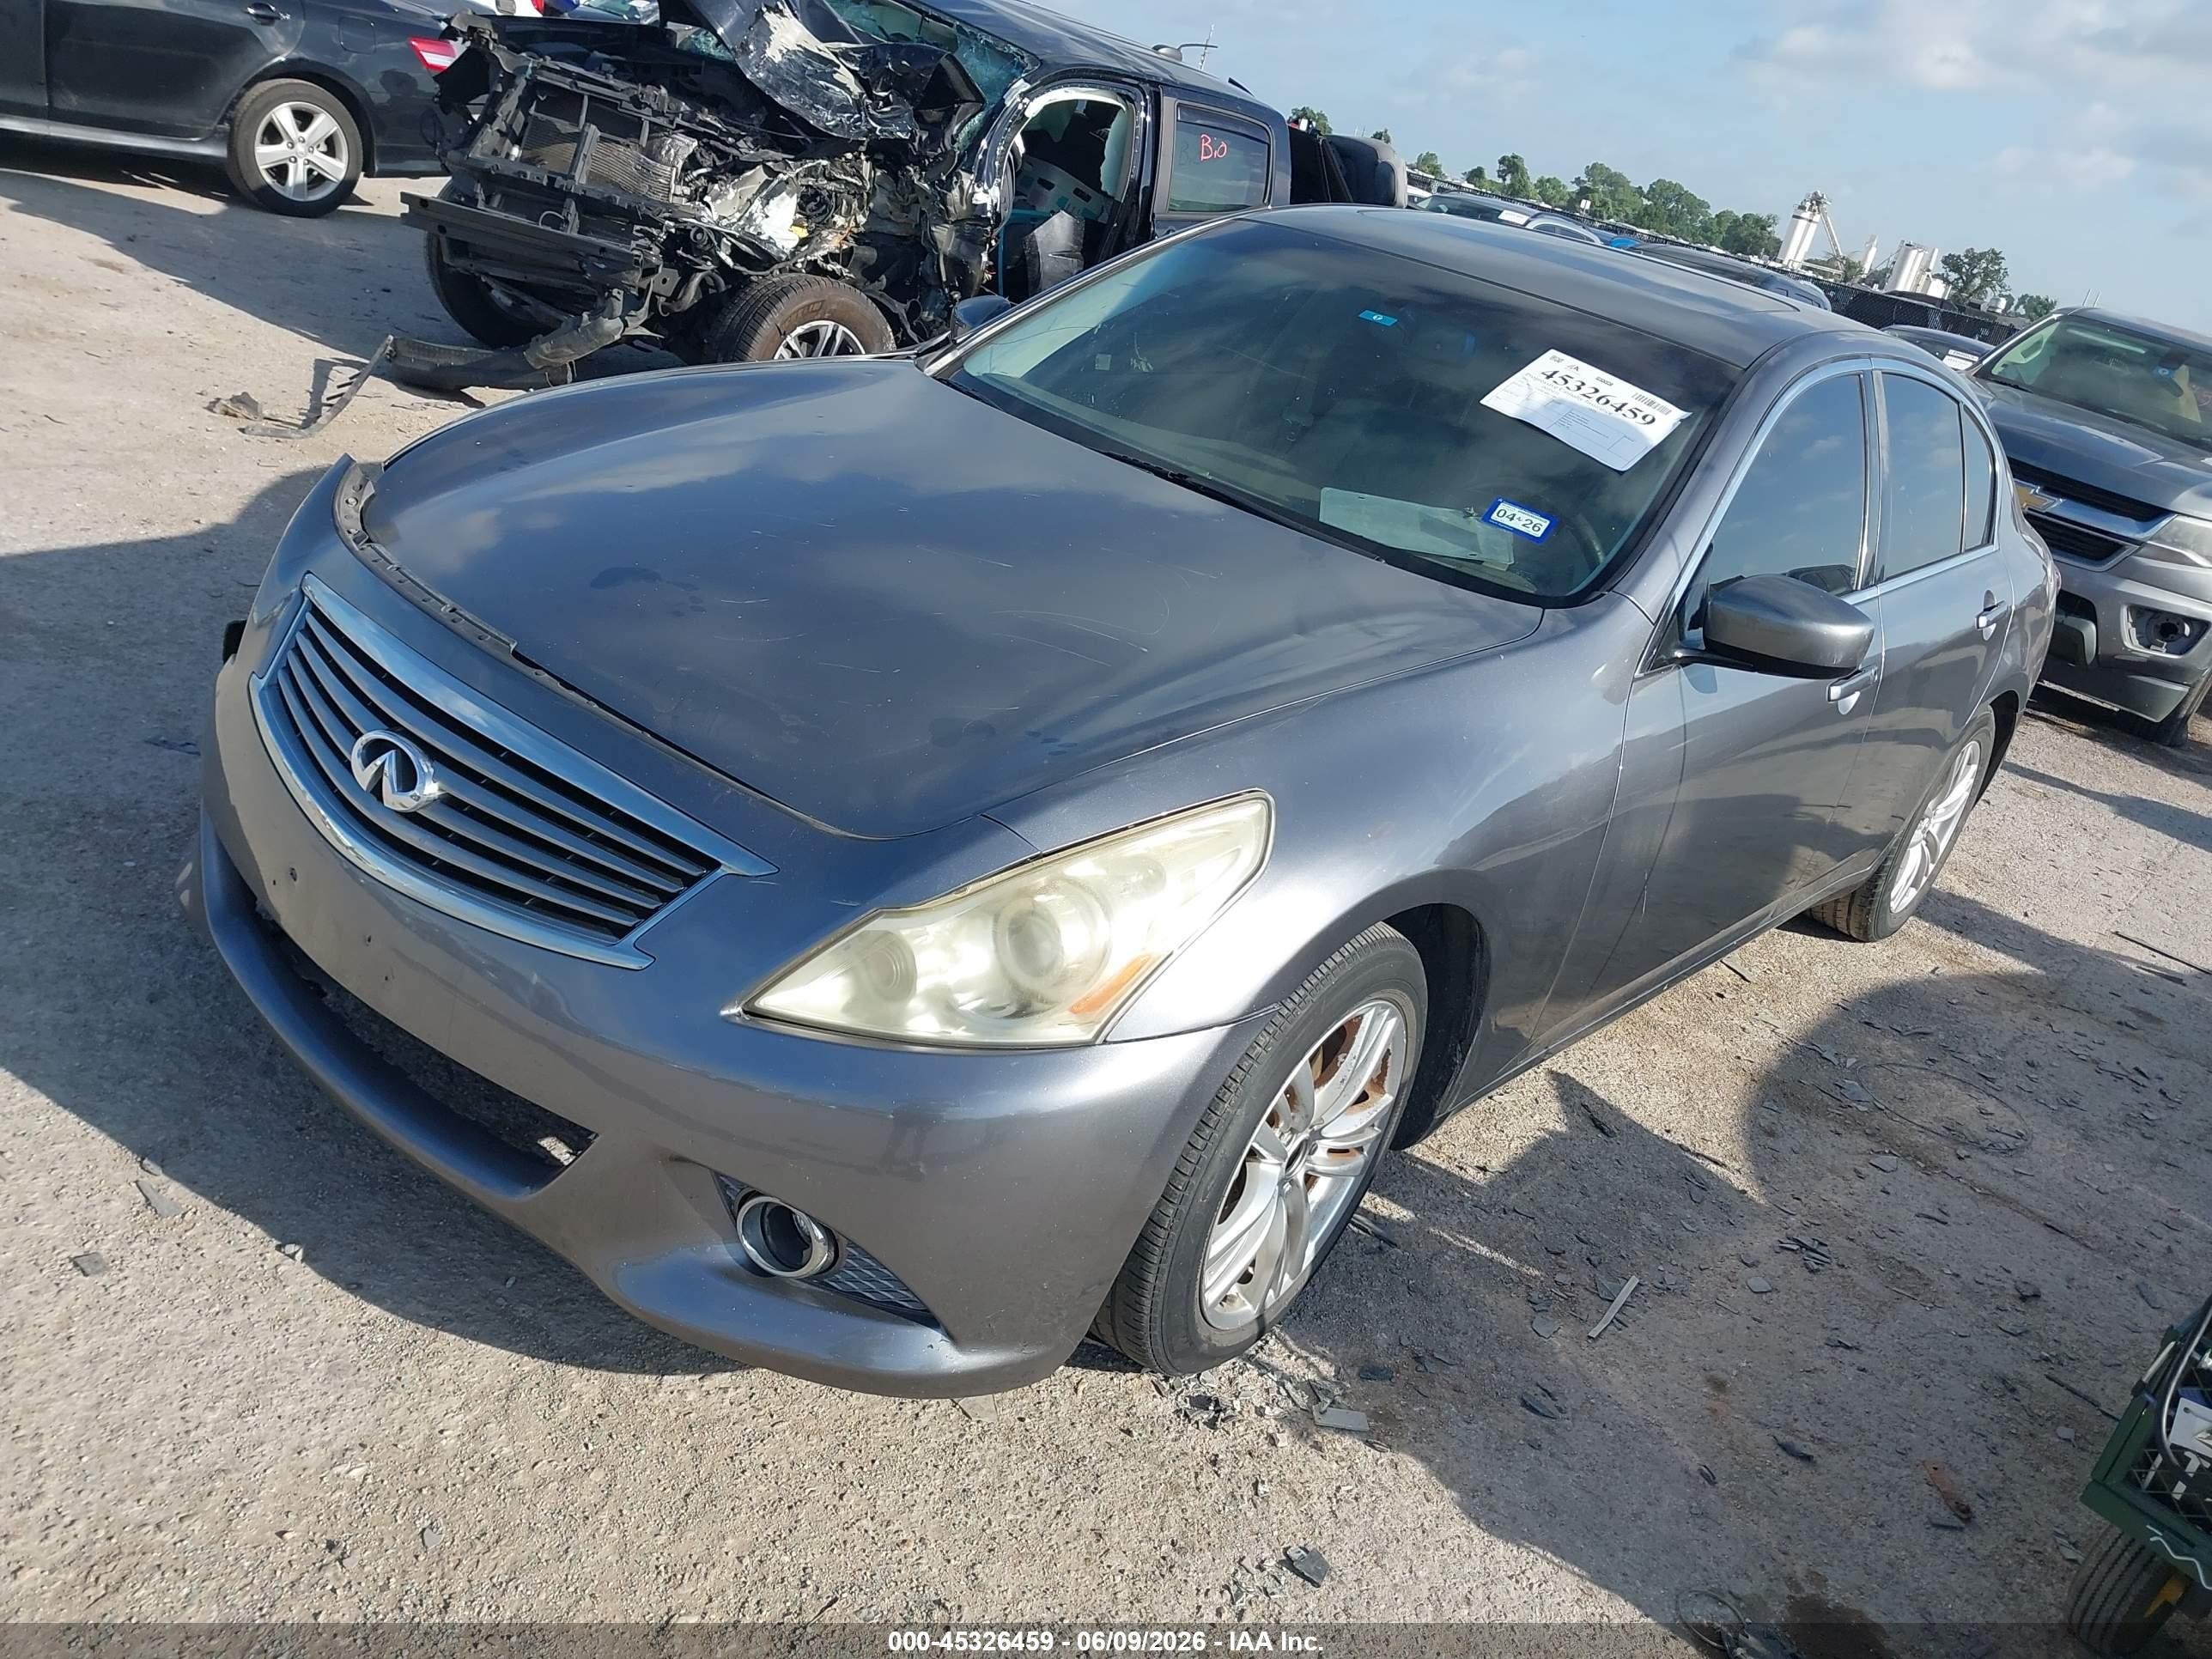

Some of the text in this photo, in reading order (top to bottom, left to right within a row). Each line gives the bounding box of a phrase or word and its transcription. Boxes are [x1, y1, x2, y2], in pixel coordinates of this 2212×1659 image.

[1200, 134, 1227, 161] Bio
[1540, 370, 1656, 425] 45326459
[1496, 507, 1517, 522] 04
[1522, 518, 1543, 532] 26
